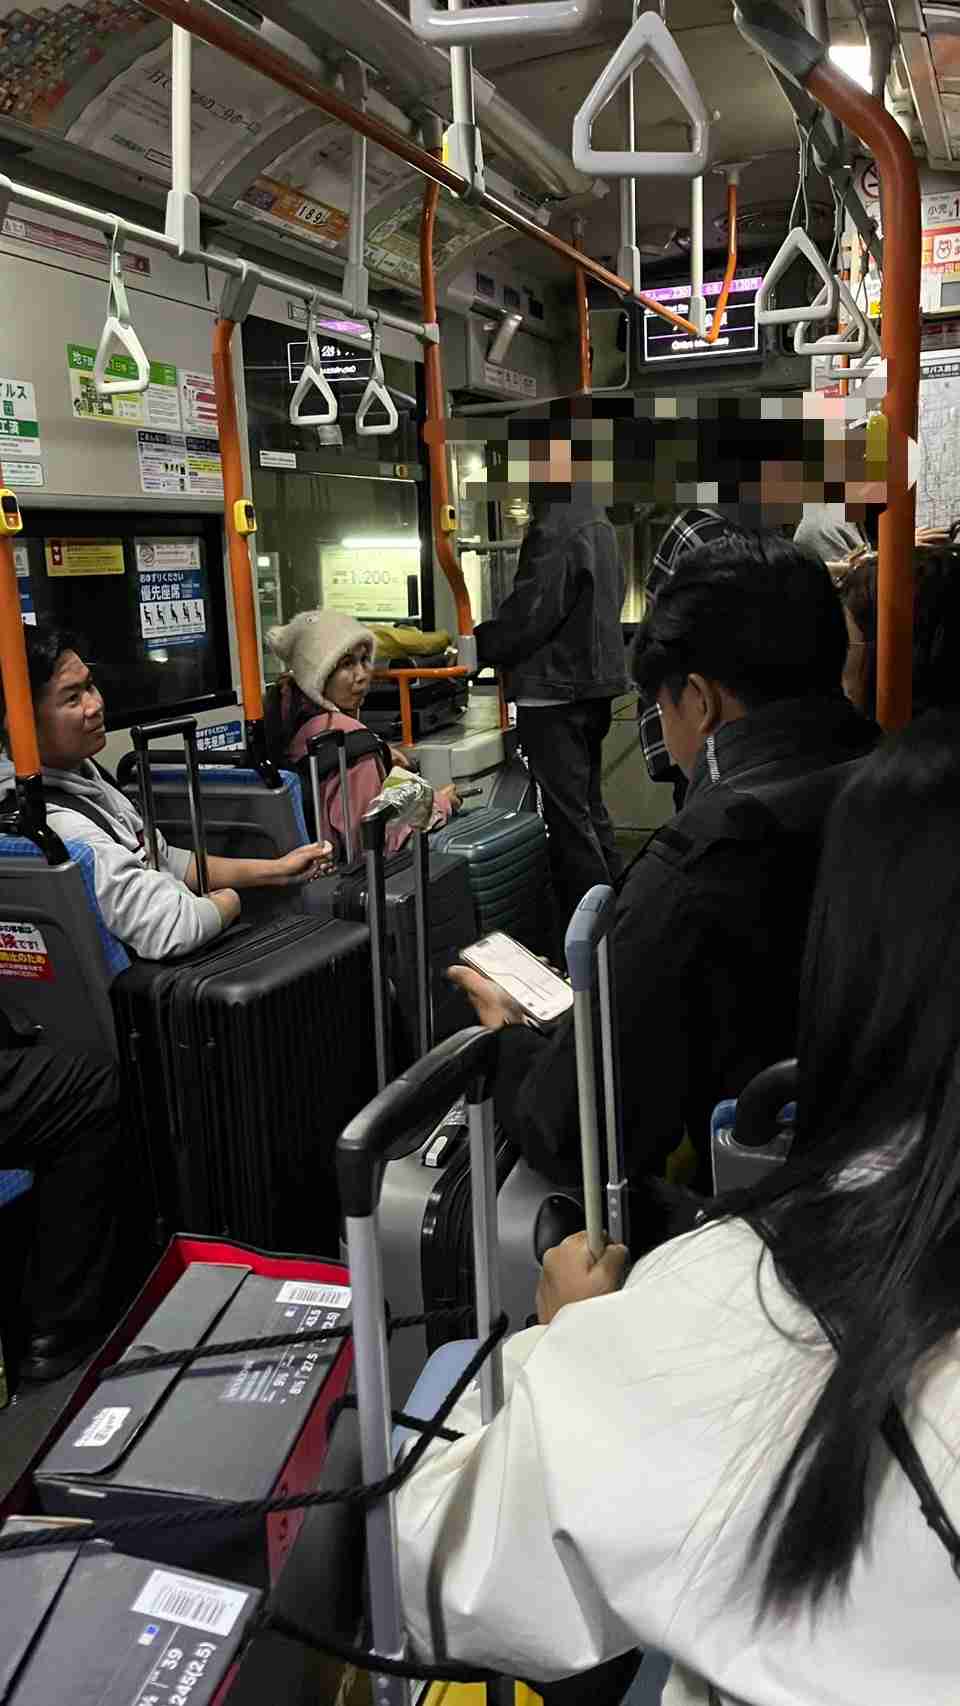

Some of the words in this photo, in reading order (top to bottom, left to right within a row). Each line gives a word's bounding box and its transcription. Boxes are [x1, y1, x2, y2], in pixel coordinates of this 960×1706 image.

[0, 382, 28, 400] ルス
[139, 571, 184, 583] おゆずりください
[140, 583, 181, 601] 優先座席
[161, 1647, 184, 1670] 39
[169, 1641, 218, 1706] 245(2.5)
